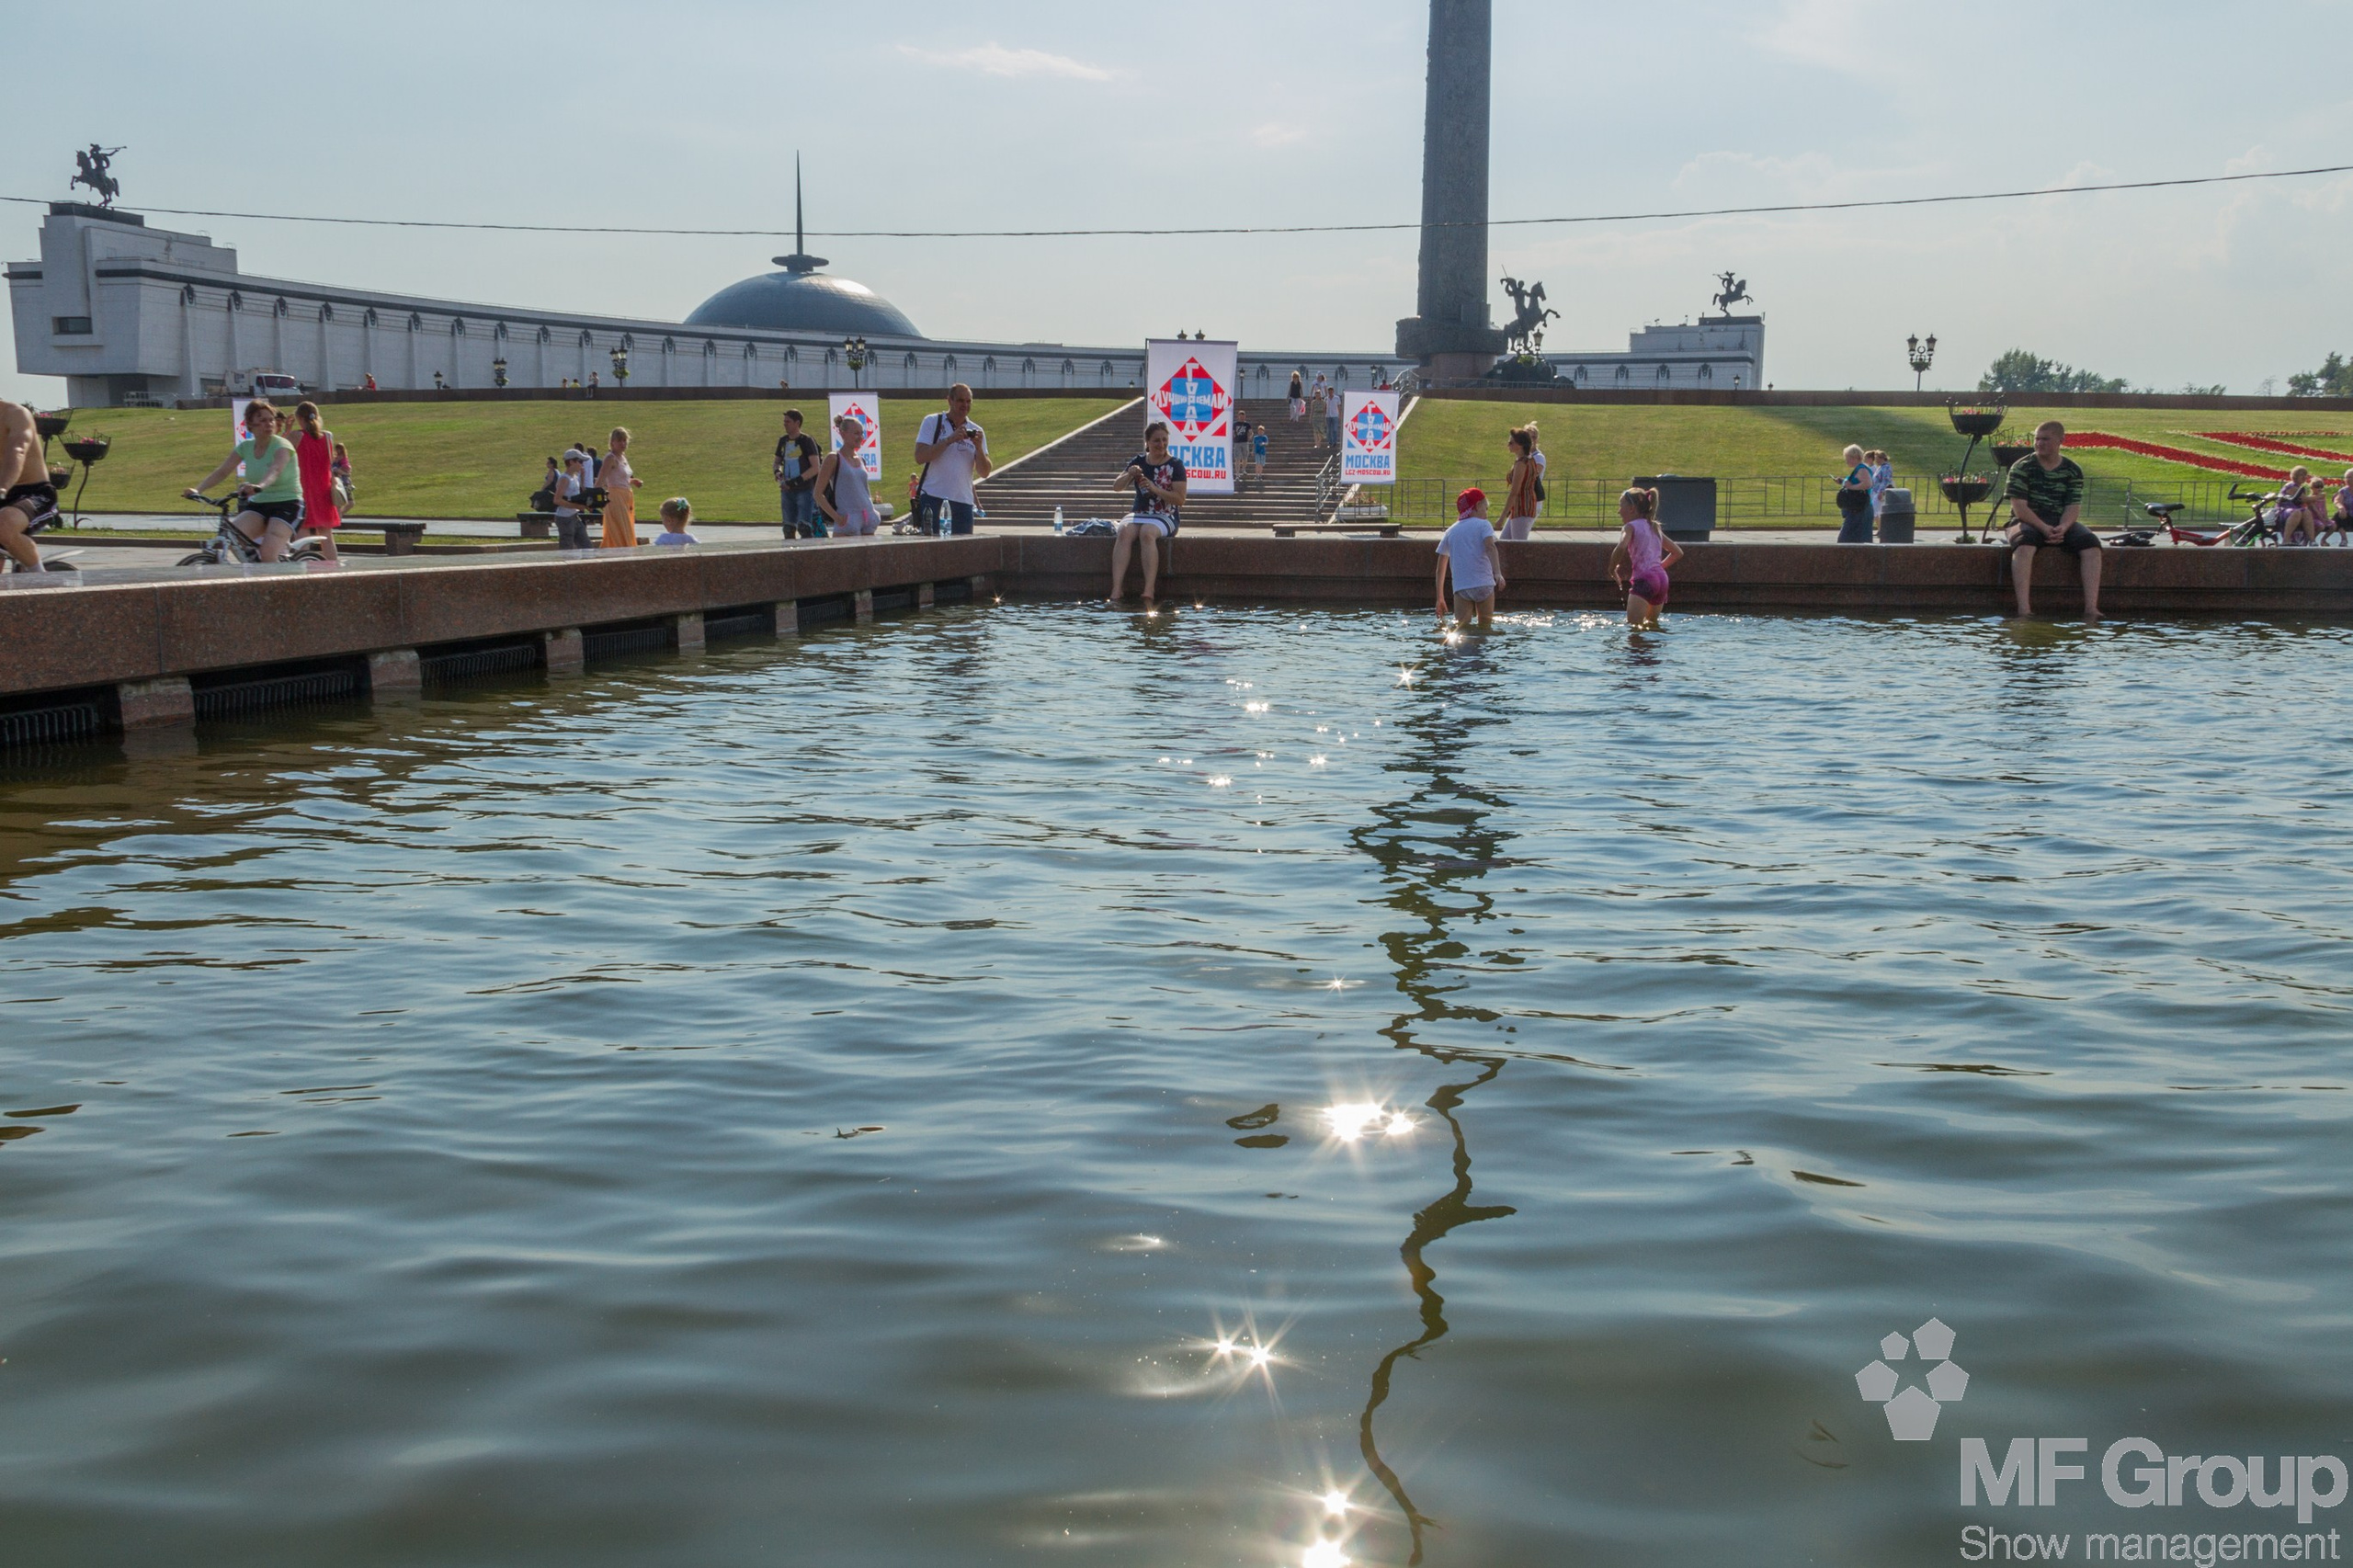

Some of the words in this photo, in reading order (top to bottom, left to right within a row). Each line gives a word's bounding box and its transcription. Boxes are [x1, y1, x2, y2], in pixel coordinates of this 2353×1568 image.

[1168, 445, 1226, 468] ОСКВА
[1346, 454, 1390, 468] МОСКВА
[1186, 470, 1226, 479] SCOW.RU
